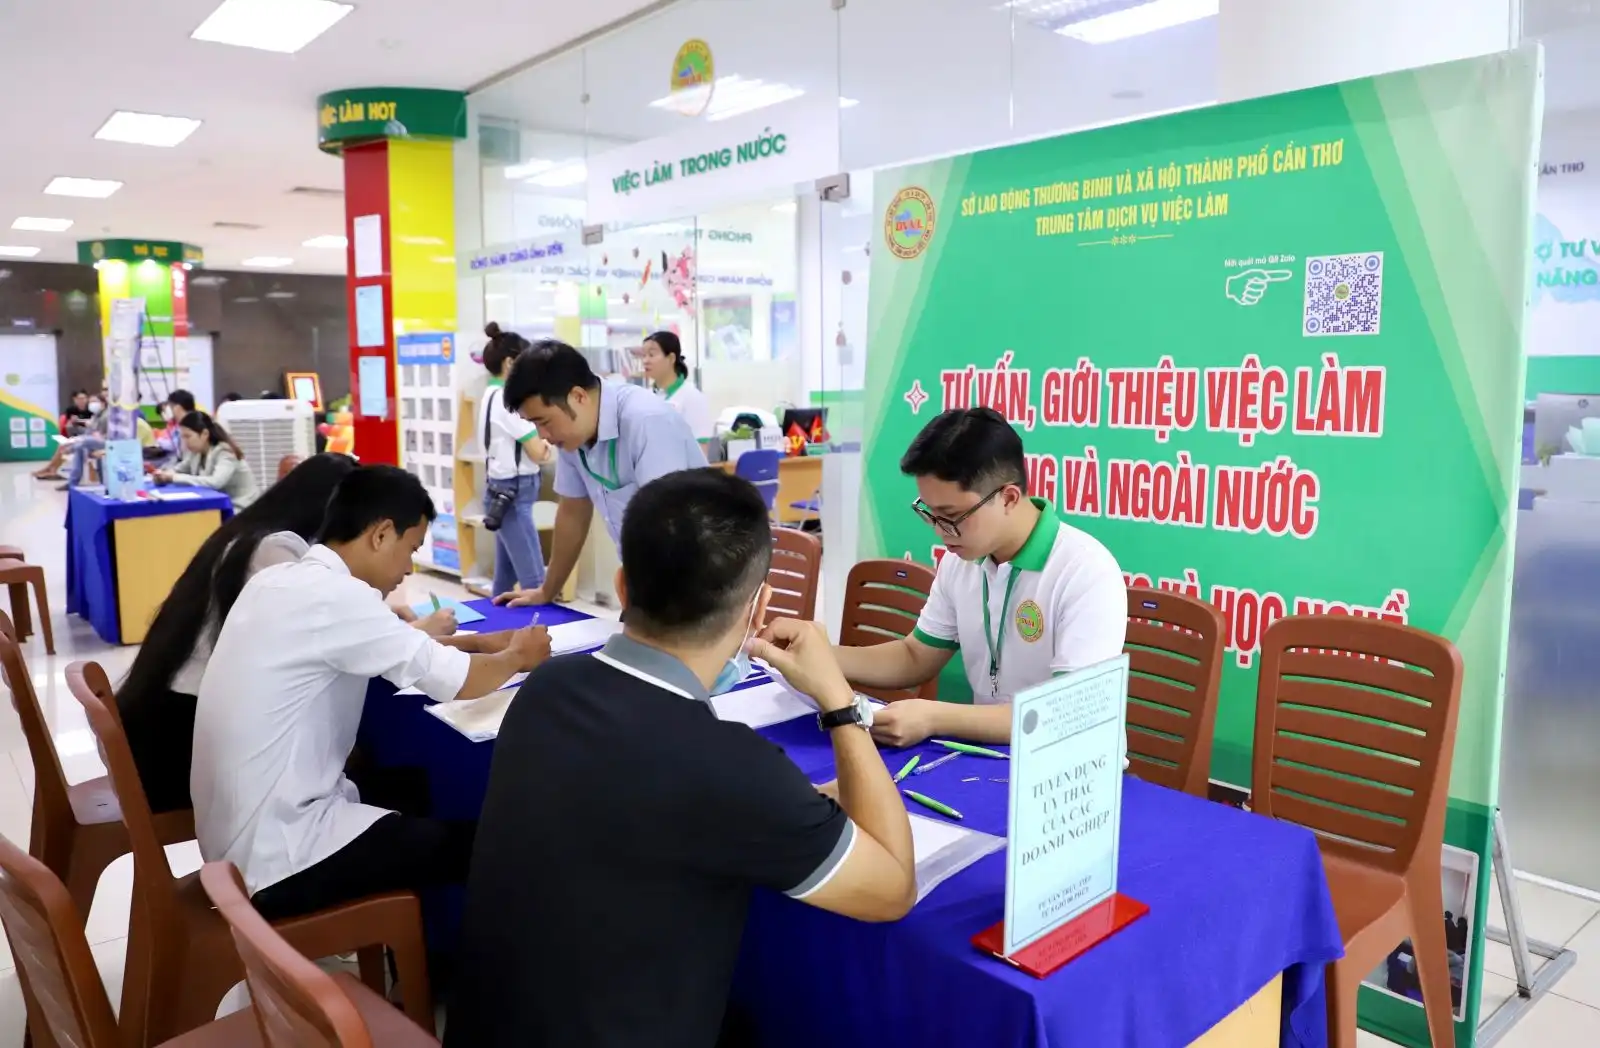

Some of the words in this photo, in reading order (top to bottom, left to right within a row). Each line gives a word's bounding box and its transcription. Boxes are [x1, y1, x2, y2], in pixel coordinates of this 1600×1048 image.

[338, 98, 364, 123] LÀM
[368, 101, 397, 120] HOT
[612, 169, 641, 196] VIỆC
[644, 160, 673, 187] LÀM
[680, 148, 732, 177] TRONG
[736, 126, 787, 163] NƯỚC
[961, 191, 976, 216] SỞ
[978, 193, 998, 214] LAO
[1000, 187, 1031, 214] ĐỘNG
[1034, 181, 1079, 206] THƯƠNG
[1082, 176, 1113, 199] BINH
[1116, 169, 1132, 194] VÀ
[1136, 166, 1154, 192] XÃ
[1158, 162, 1182, 192] HỘI
[1185, 157, 1233, 185] THÀNH
[1237, 144, 1269, 178] PHỐ
[1273, 140, 1306, 173] CẦN
[1310, 138, 1344, 167] THƠ
[1036, 212, 1074, 236] TRUNG
[1077, 207, 1103, 231] TÂM
[1107, 204, 1137, 231] DỊCH
[1141, 202, 1159, 228] VỤ
[1162, 195, 1193, 225] VIỆC
[1197, 191, 1229, 219] LÀM
[1042, 357, 1101, 426] GIỚI
[1107, 355, 1199, 443] THIỆU
[1204, 354, 1288, 446] VIỆC
[1293, 352, 1386, 437] LÀM
[1064, 446, 1101, 516] VÀ
[1107, 450, 1209, 528] NGOÀI
[1212, 455, 1320, 539] NƯỚC
[1022, 832, 1065, 866] DOANH
